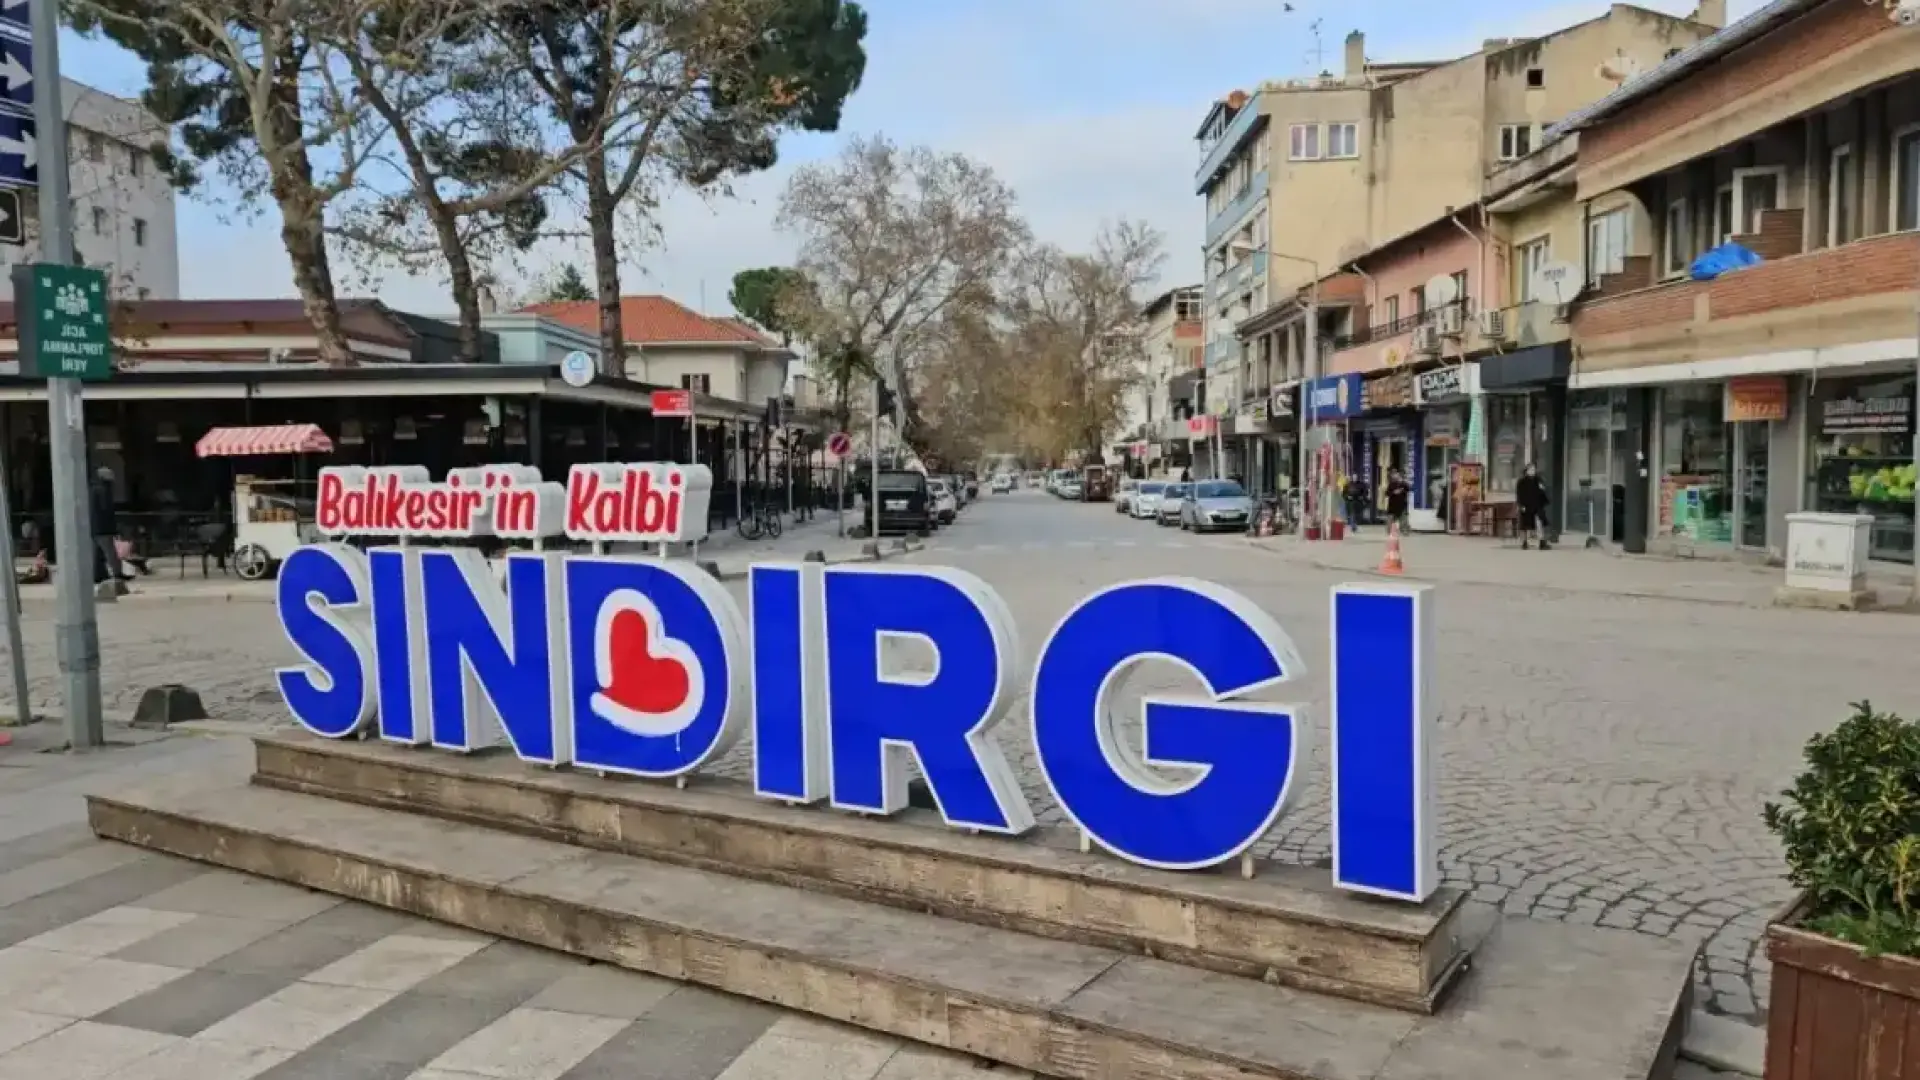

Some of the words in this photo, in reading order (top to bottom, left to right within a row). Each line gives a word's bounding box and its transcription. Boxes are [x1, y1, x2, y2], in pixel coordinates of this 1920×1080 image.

[316, 472, 539, 534] Balıkesir'in
[567, 469, 684, 537] Kalbi
[275, 547, 1424, 902] SINDIRGI
